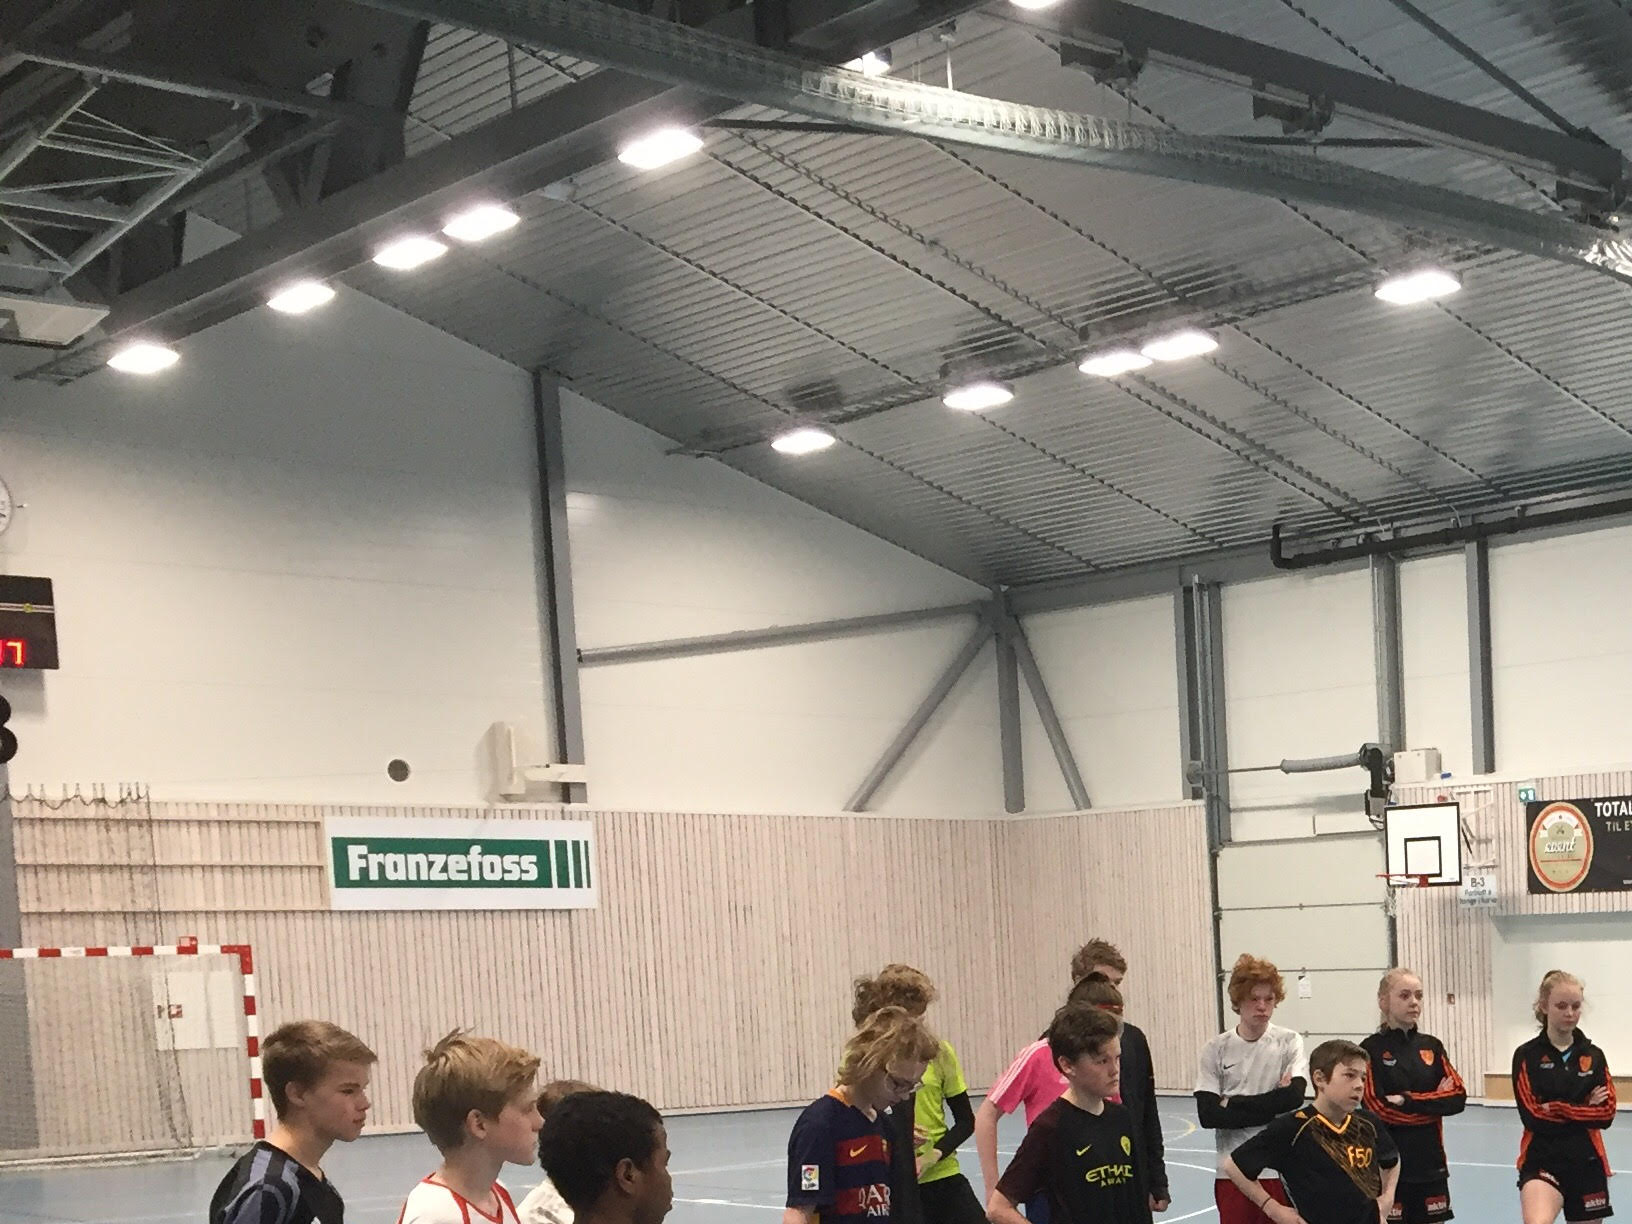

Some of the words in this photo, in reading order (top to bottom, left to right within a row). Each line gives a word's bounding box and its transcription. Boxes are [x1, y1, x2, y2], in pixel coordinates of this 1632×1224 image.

[1606, 821, 1622, 832] TIL
[347, 844, 538, 881] Franzefoss
[1470, 876, 1485, 888] B-3
